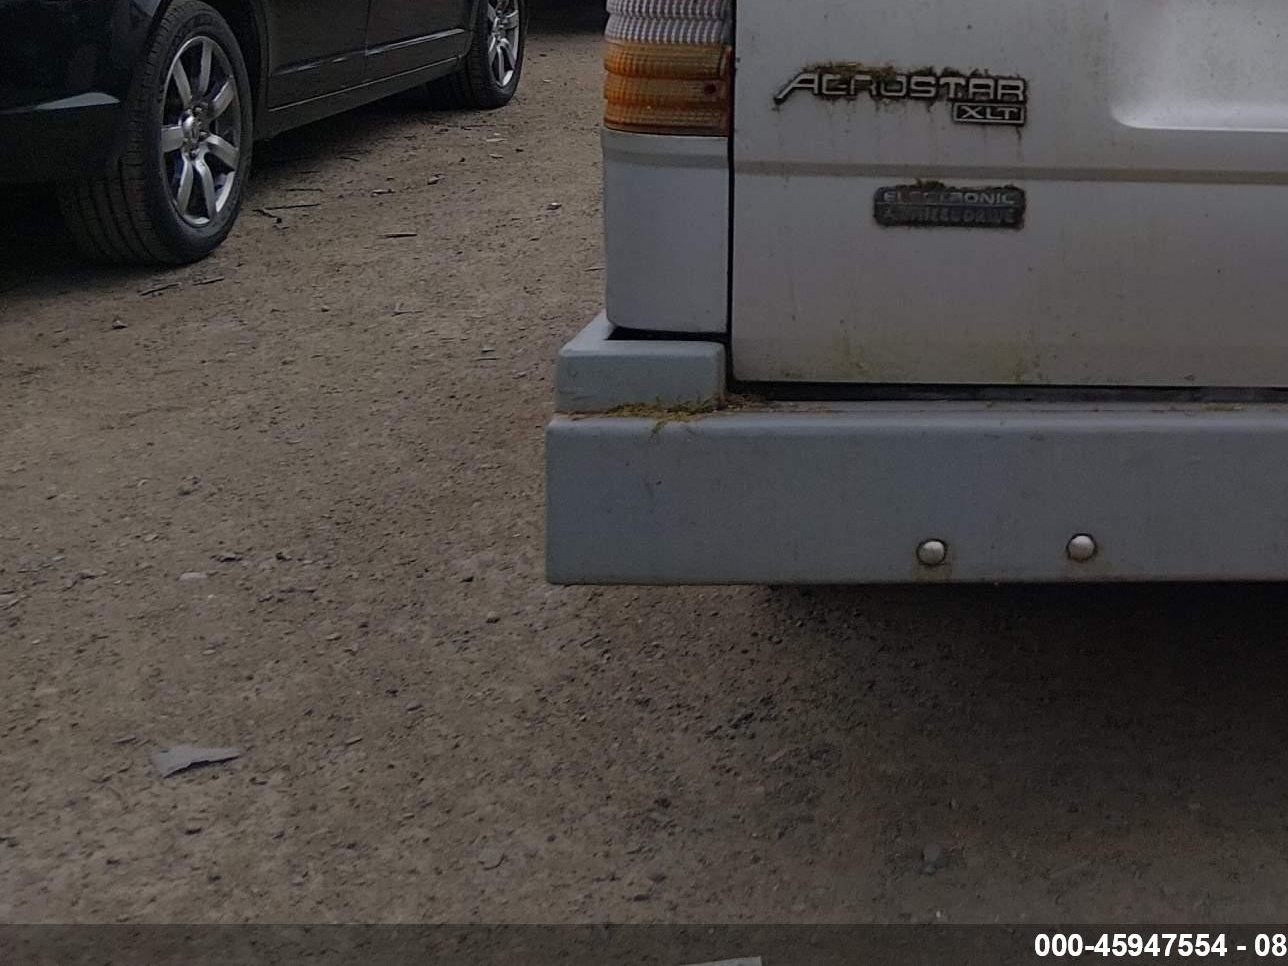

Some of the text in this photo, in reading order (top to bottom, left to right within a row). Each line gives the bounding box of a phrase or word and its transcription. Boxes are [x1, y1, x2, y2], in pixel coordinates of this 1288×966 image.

[774, 73, 1025, 101] AEROSTAR
[961, 106, 1018, 120] XLT
[883, 191, 1015, 204] ELRONIC
